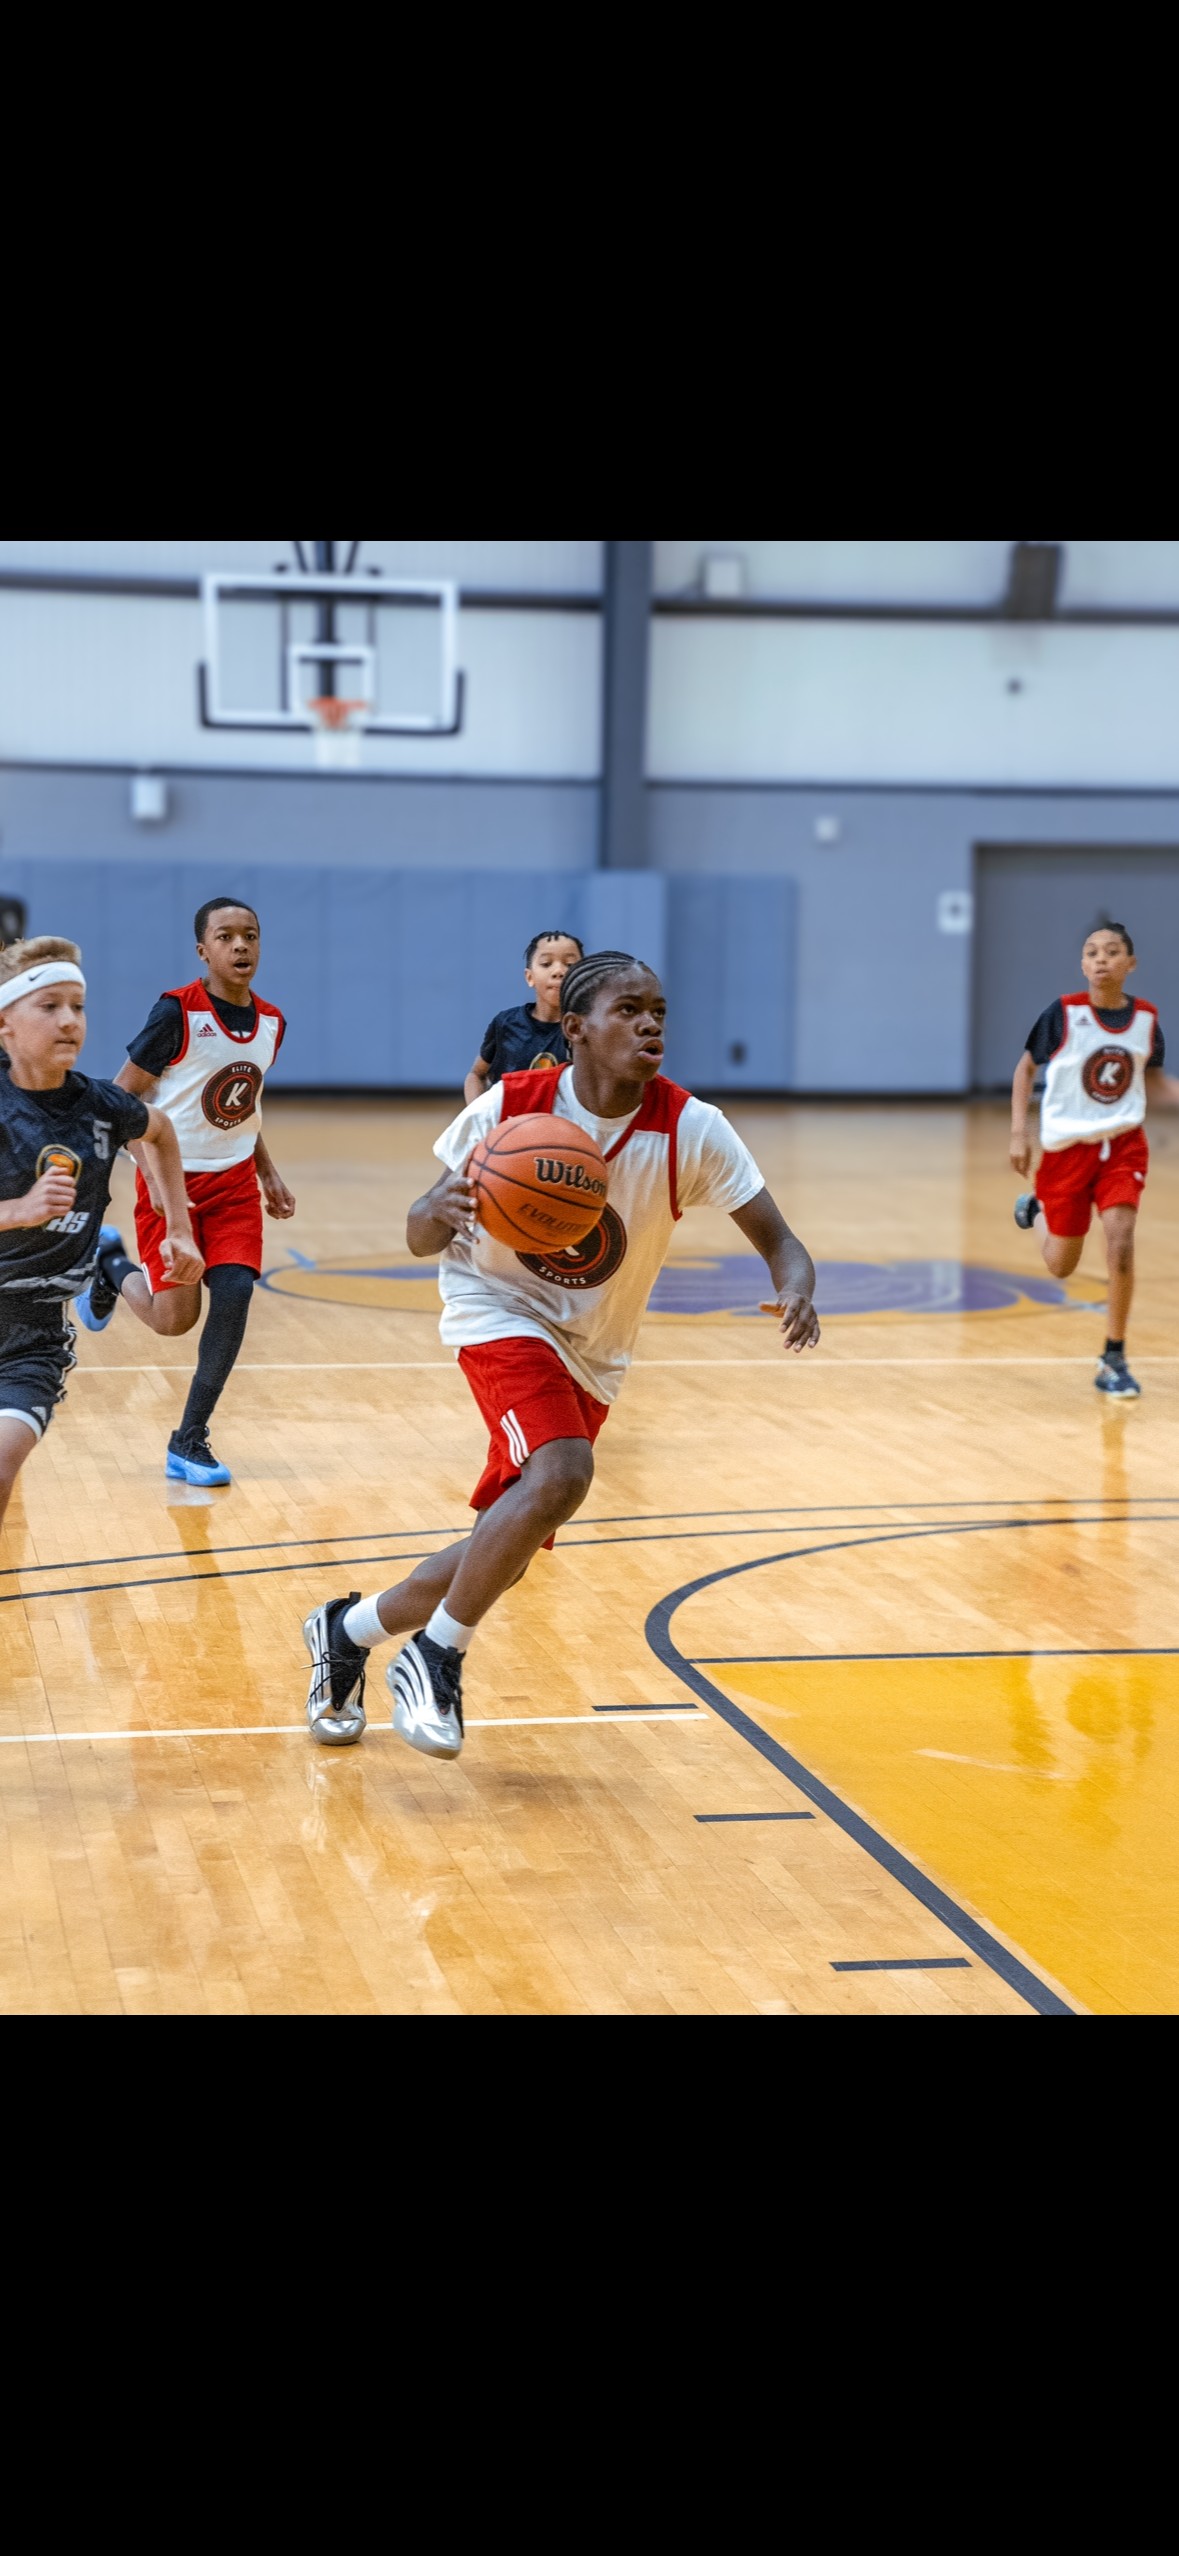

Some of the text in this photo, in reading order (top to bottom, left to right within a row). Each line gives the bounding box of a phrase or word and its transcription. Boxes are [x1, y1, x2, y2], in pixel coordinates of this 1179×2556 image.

[231, 1065, 252, 1073] ELITE
[1099, 1061, 1120, 1086] K
[225, 1082, 248, 1107] K
[93, 1120, 112, 1160] 5
[535, 1158, 606, 1197] Wilson
[539, 1266, 587, 1285] SPORTS
